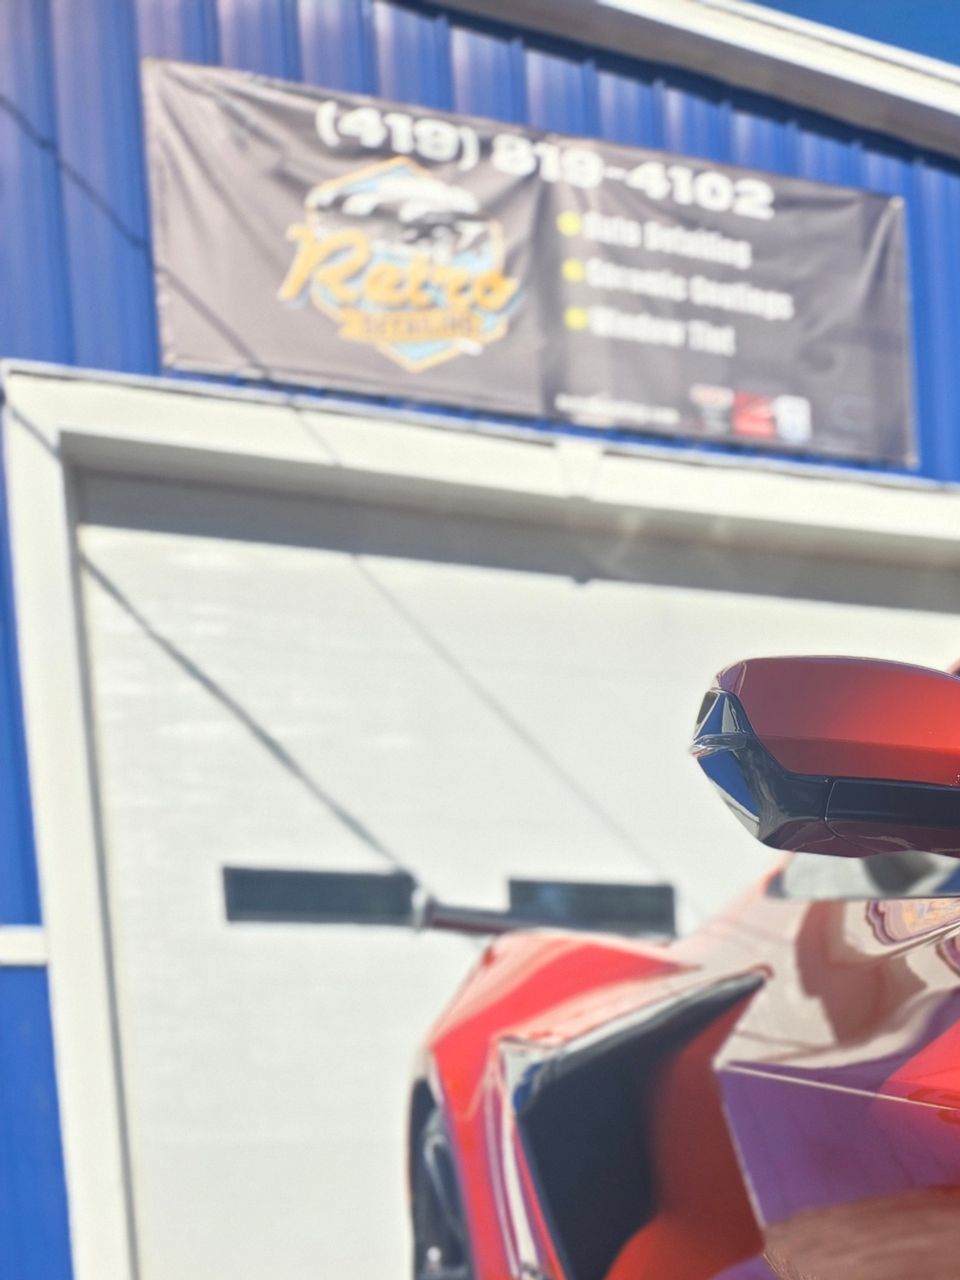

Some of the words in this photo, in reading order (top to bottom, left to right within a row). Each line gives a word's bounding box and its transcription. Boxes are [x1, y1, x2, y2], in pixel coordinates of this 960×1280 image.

[315, 101, 480, 172] (419)
[490, 132, 775, 221] 819-4102
[277, 222, 521, 310] Retro
